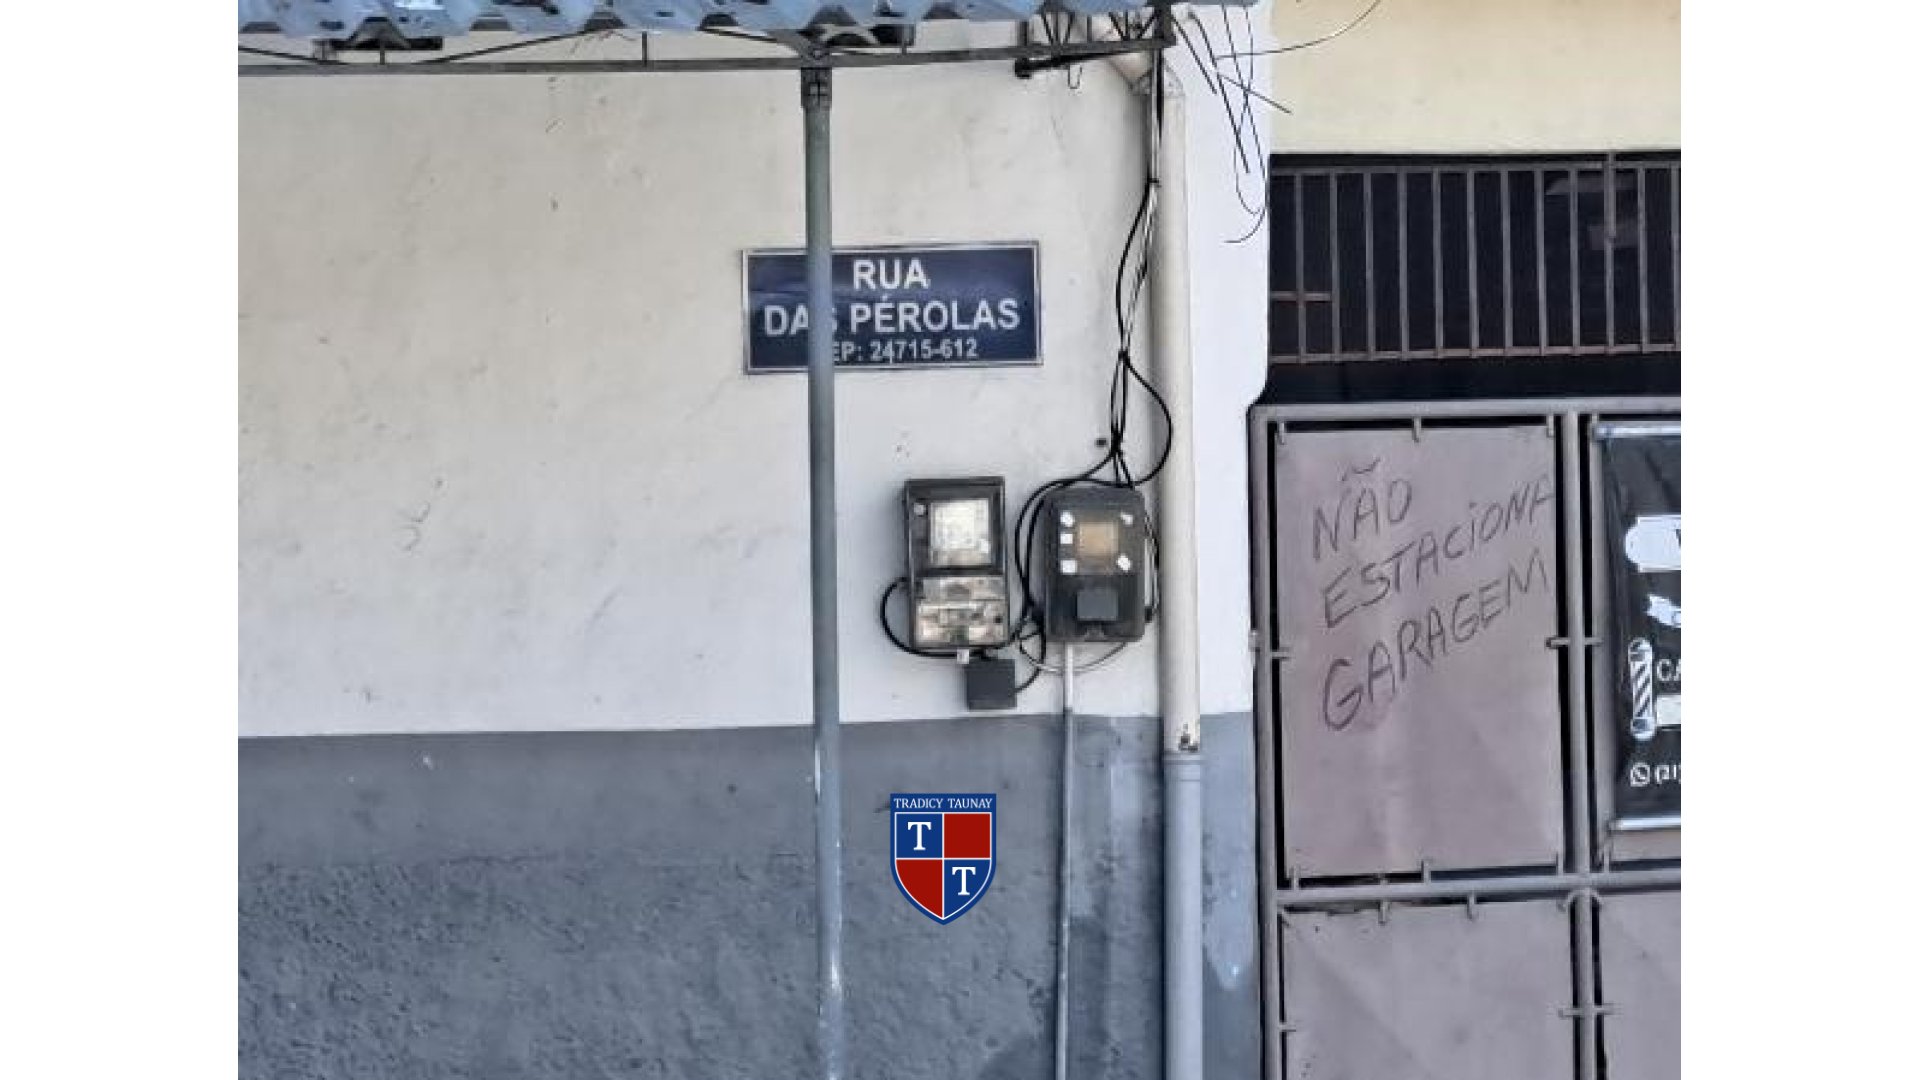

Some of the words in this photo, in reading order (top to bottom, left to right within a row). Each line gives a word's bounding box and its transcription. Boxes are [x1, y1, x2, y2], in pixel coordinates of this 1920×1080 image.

[853, 257, 930, 291] RUA
[763, 304, 838, 337] DA
[850, 295, 1021, 333] PÉROLAS
[832, 339, 864, 362] EP:
[869, 337, 979, 361] 24715-612
[1312, 457, 1412, 561] NÃO
[1322, 547, 1548, 732] GARAGEM
